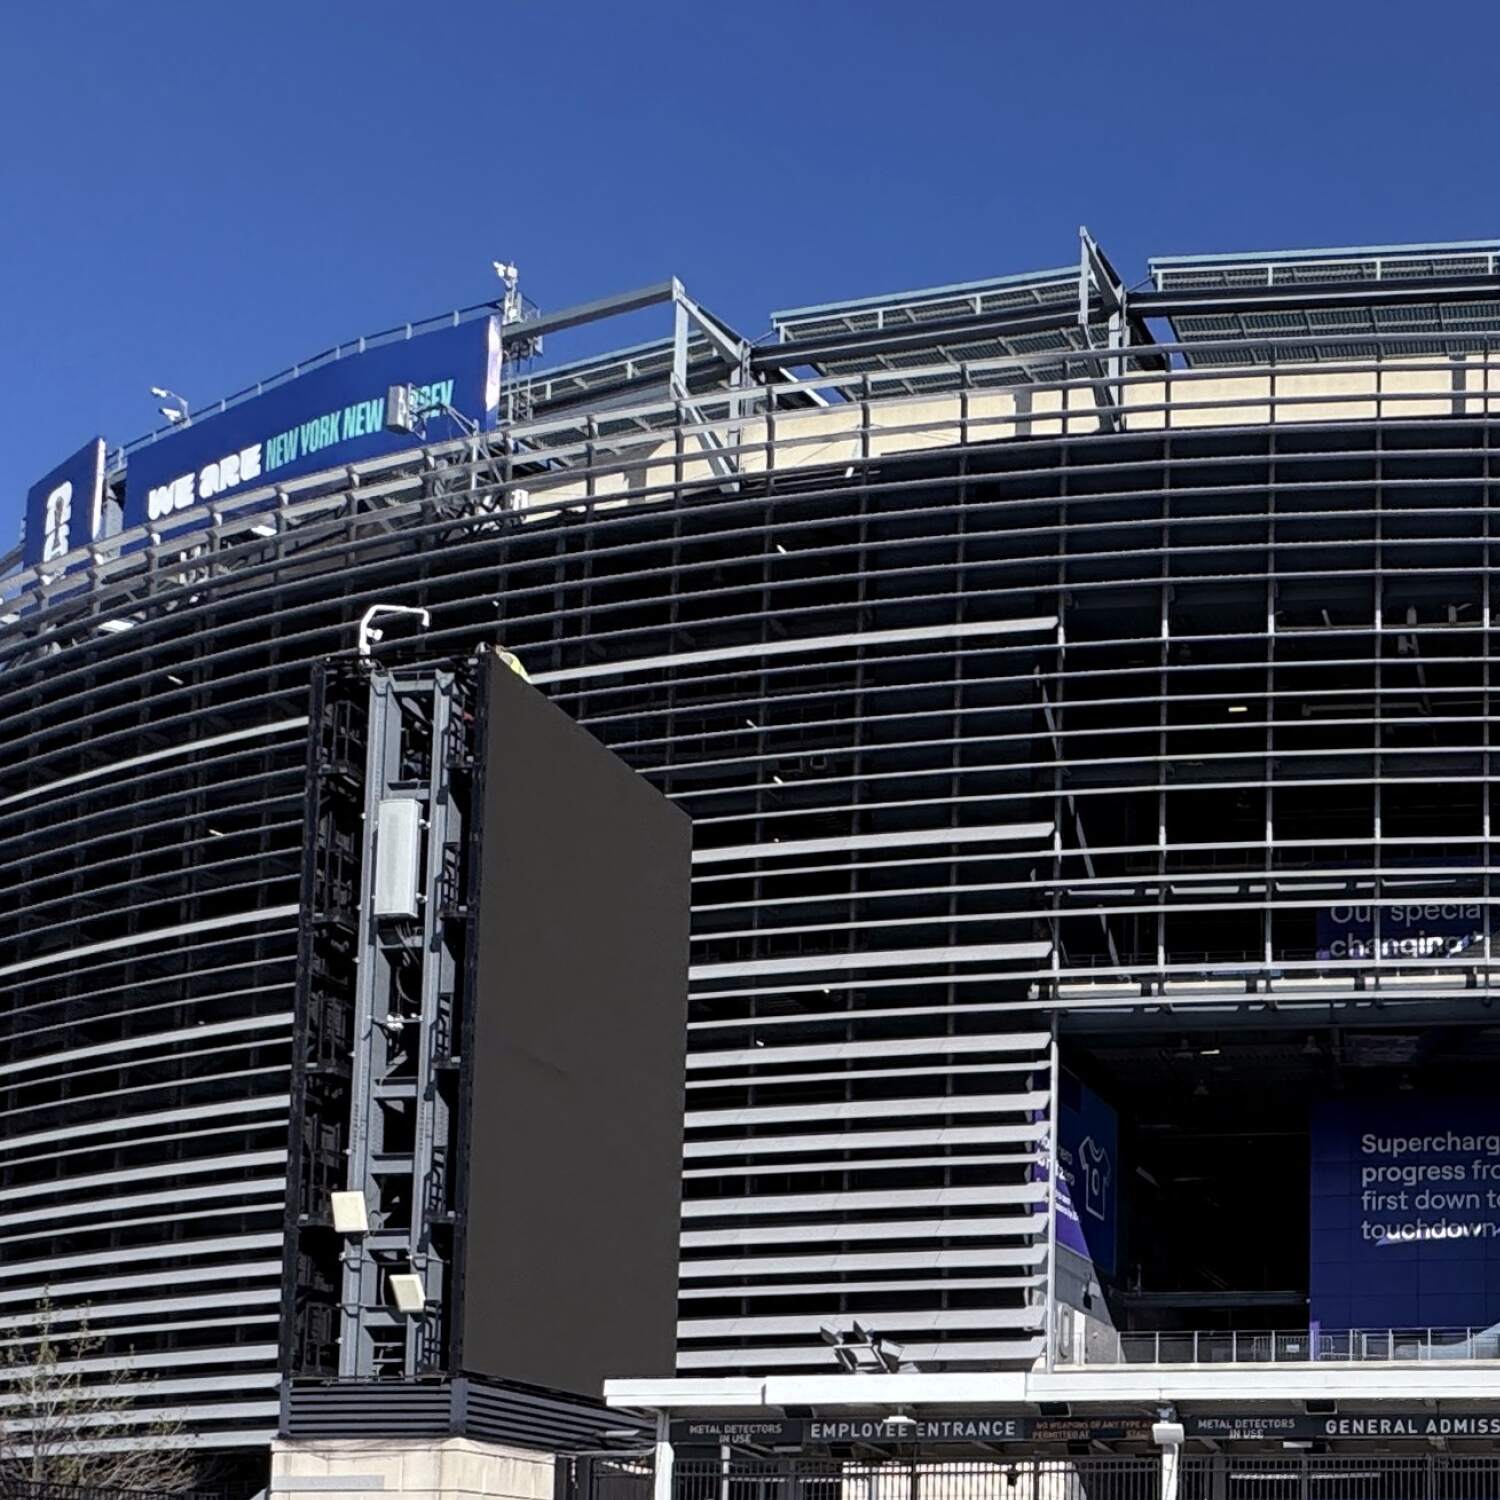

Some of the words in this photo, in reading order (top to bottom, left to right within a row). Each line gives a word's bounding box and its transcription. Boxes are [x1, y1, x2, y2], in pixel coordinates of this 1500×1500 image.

[147, 473, 196, 521] WE
[199, 443, 262, 499] ARE
[265, 427, 300, 473] NEW
[300, 416, 341, 456] YORK
[342, 397, 385, 440] NEW
[1330, 903, 1375, 923] Ou
[1391, 903, 1483, 927] specia
[1362, 1164, 1466, 1187] progress
[1361, 1190, 1408, 1211] first
[1415, 1189, 1480, 1210] down
[1361, 1218, 1497, 1239] touchdown
[689, 1424, 721, 1434] METAL
[724, 1424, 783, 1434] DETECTORS
[810, 1422, 909, 1438] EMPLOYEE
[916, 1420, 1016, 1437] ENTRANCE
[1198, 1418, 1232, 1429] METAL
[1235, 1418, 1296, 1429] DETECTORS
[1325, 1418, 1418, 1434] GENERAL
